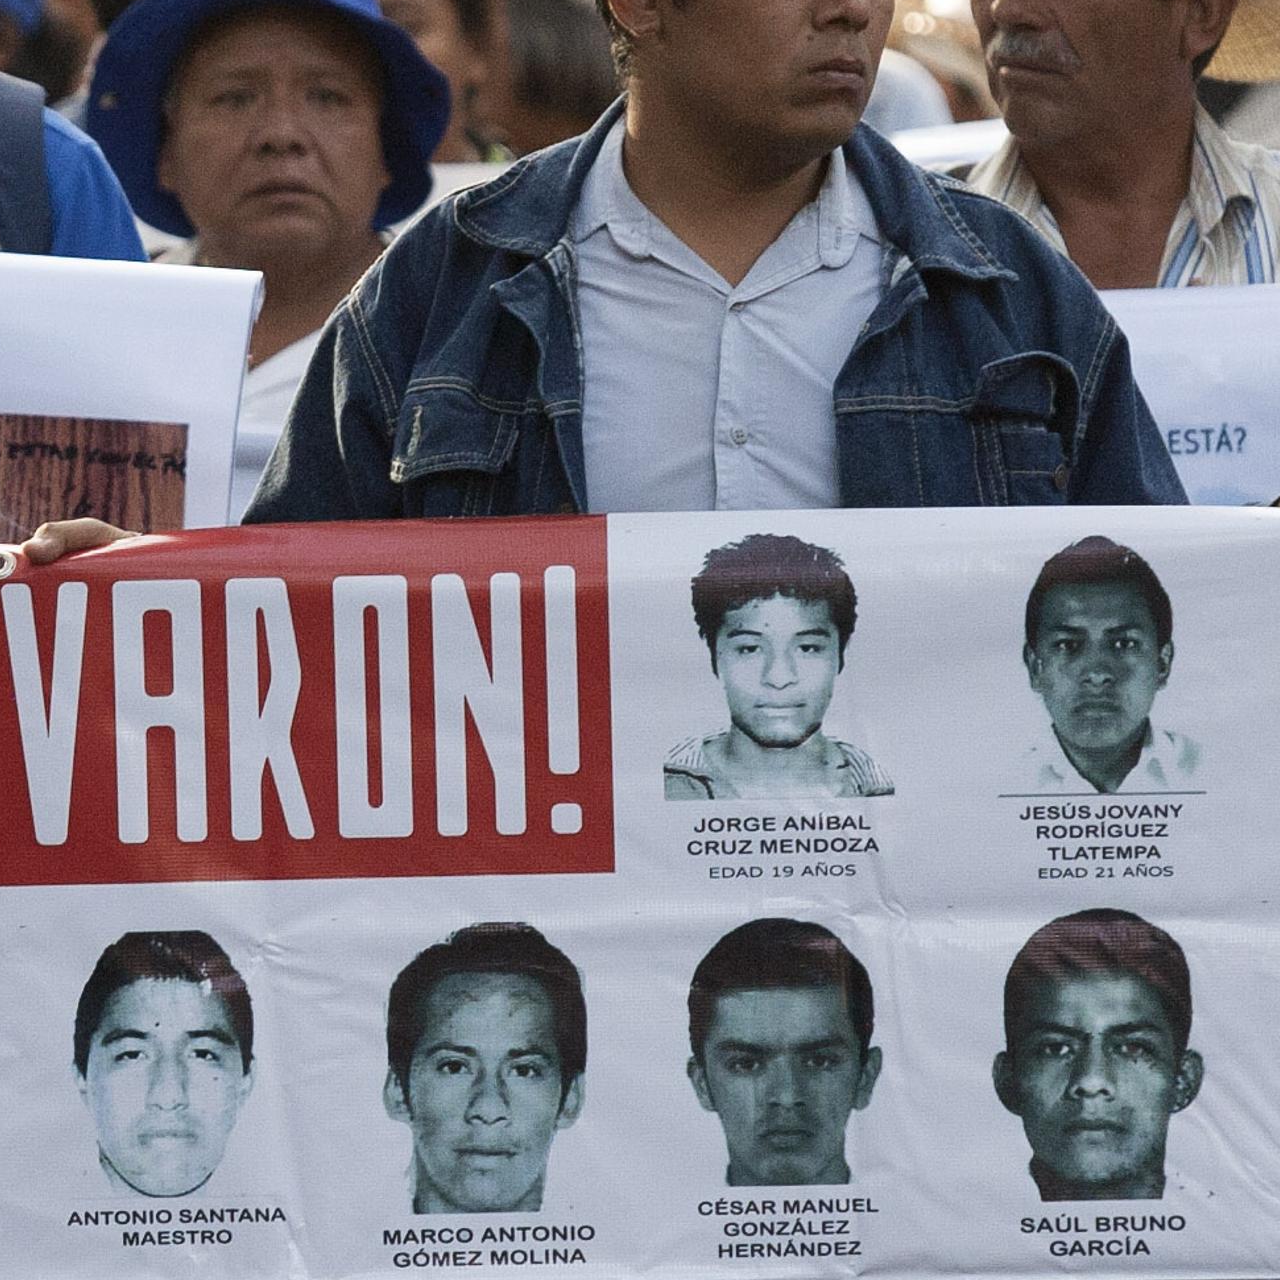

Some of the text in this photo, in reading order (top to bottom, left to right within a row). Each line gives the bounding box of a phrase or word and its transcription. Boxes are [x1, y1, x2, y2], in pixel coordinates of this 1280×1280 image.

[1167, 423, 1247, 455] ESTÁ?
[1020, 803, 1183, 821] JESÚS JOVANY
[694, 813, 872, 834] JORGE ANÍBAL
[1037, 822, 1169, 840] RODRÍGUEZ
[687, 838, 880, 856] CRUZ MENDOZA
[1047, 845, 1162, 861] TLATEMPA
[698, 1198, 879, 1217] CÉSAR MANUEL
[68, 1208, 287, 1227] ANTONIO SANTANA
[1021, 1214, 1187, 1234] SAÚL BRUNO
[383, 1225, 596, 1246] MARCO ANTONIO
[724, 1218, 850, 1238] GONZÁLEZ
[123, 1229, 233, 1247] MAESTRO
[1050, 1236, 1151, 1257] GARCÍA
[393, 1248, 587, 1269] GÓMEZ MOLINA
[719, 1240, 862, 1259] HERNÁNDEZ
